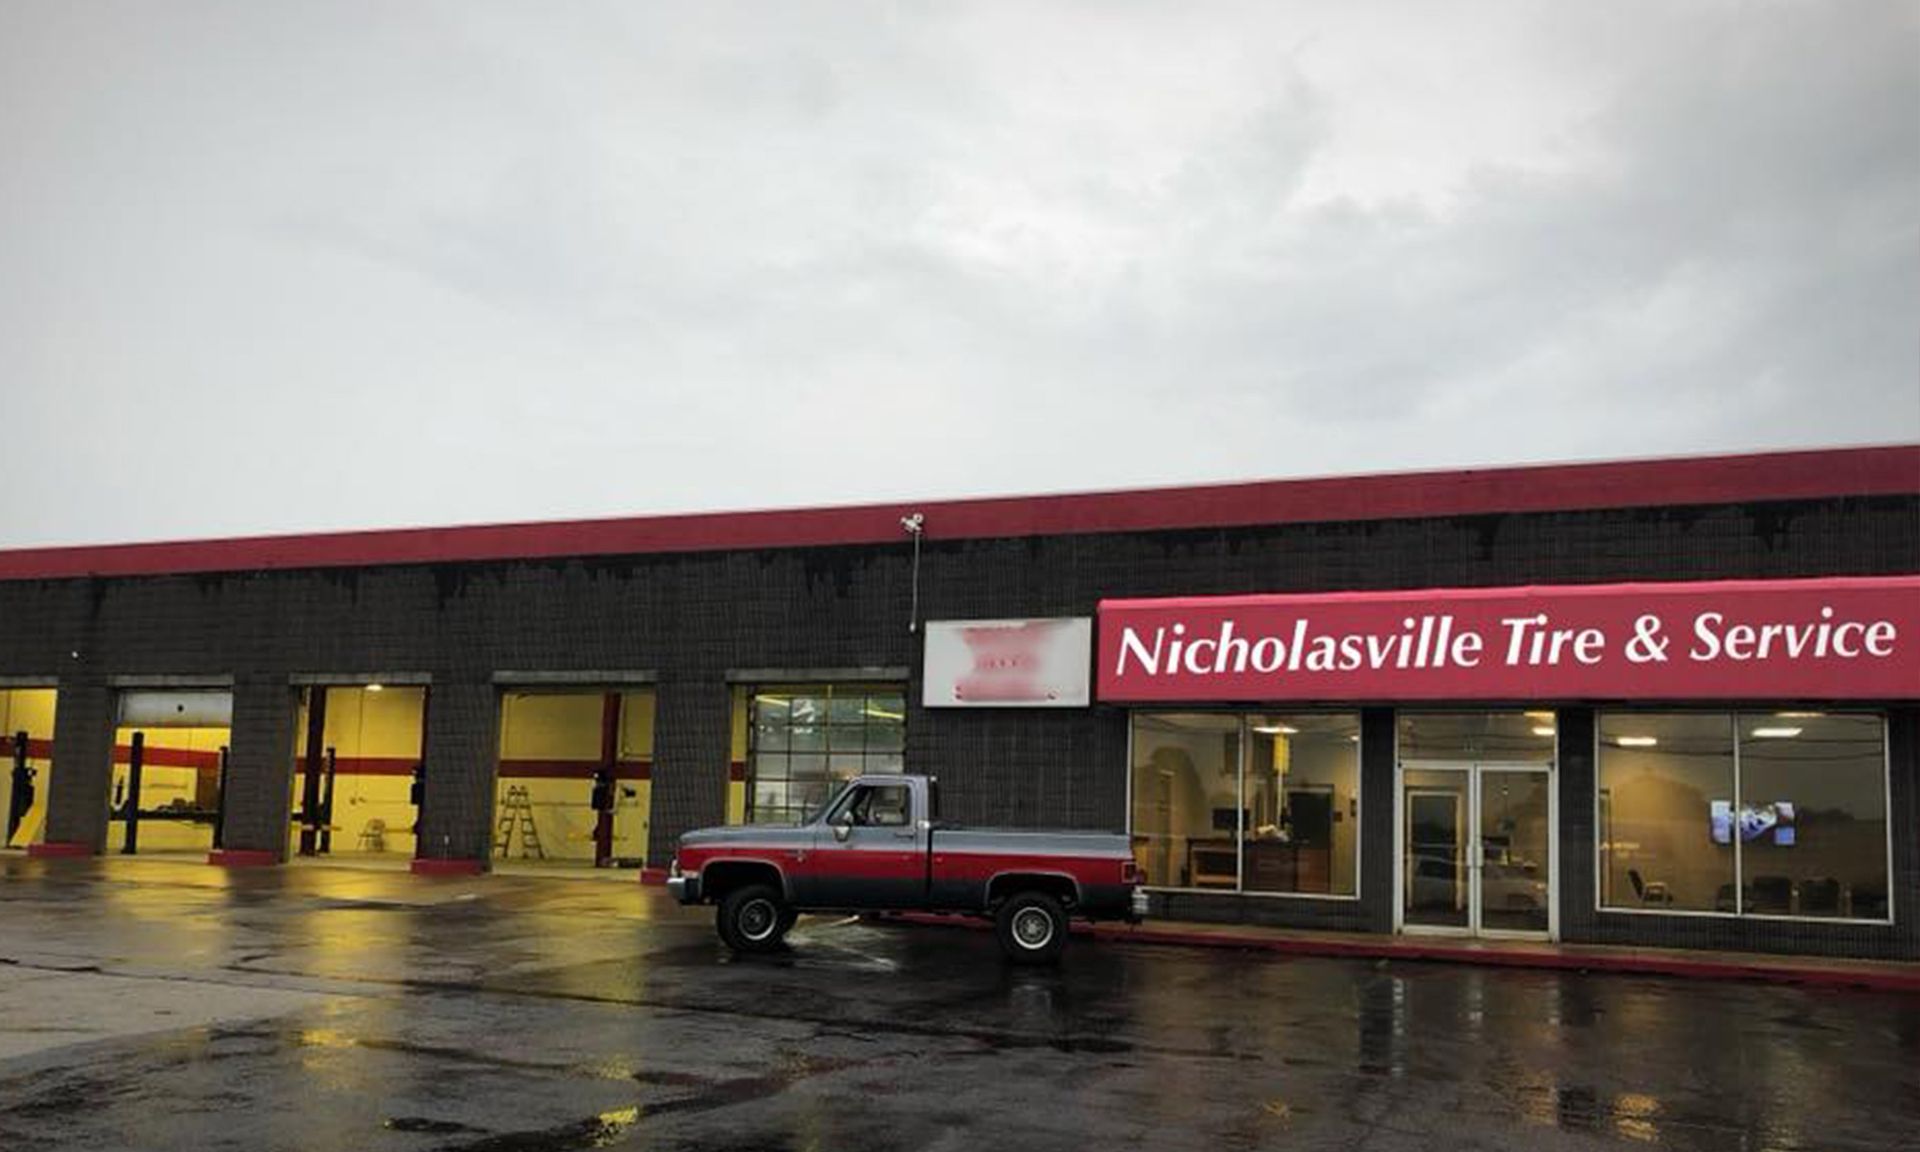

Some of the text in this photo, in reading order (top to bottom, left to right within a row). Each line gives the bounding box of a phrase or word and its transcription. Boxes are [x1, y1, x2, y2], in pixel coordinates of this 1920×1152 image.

[1115, 614, 1484, 676] Nicholasville
[1500, 612, 1606, 666] Tire
[1624, 614, 1670, 664] &
[1689, 606, 1897, 662] Service
